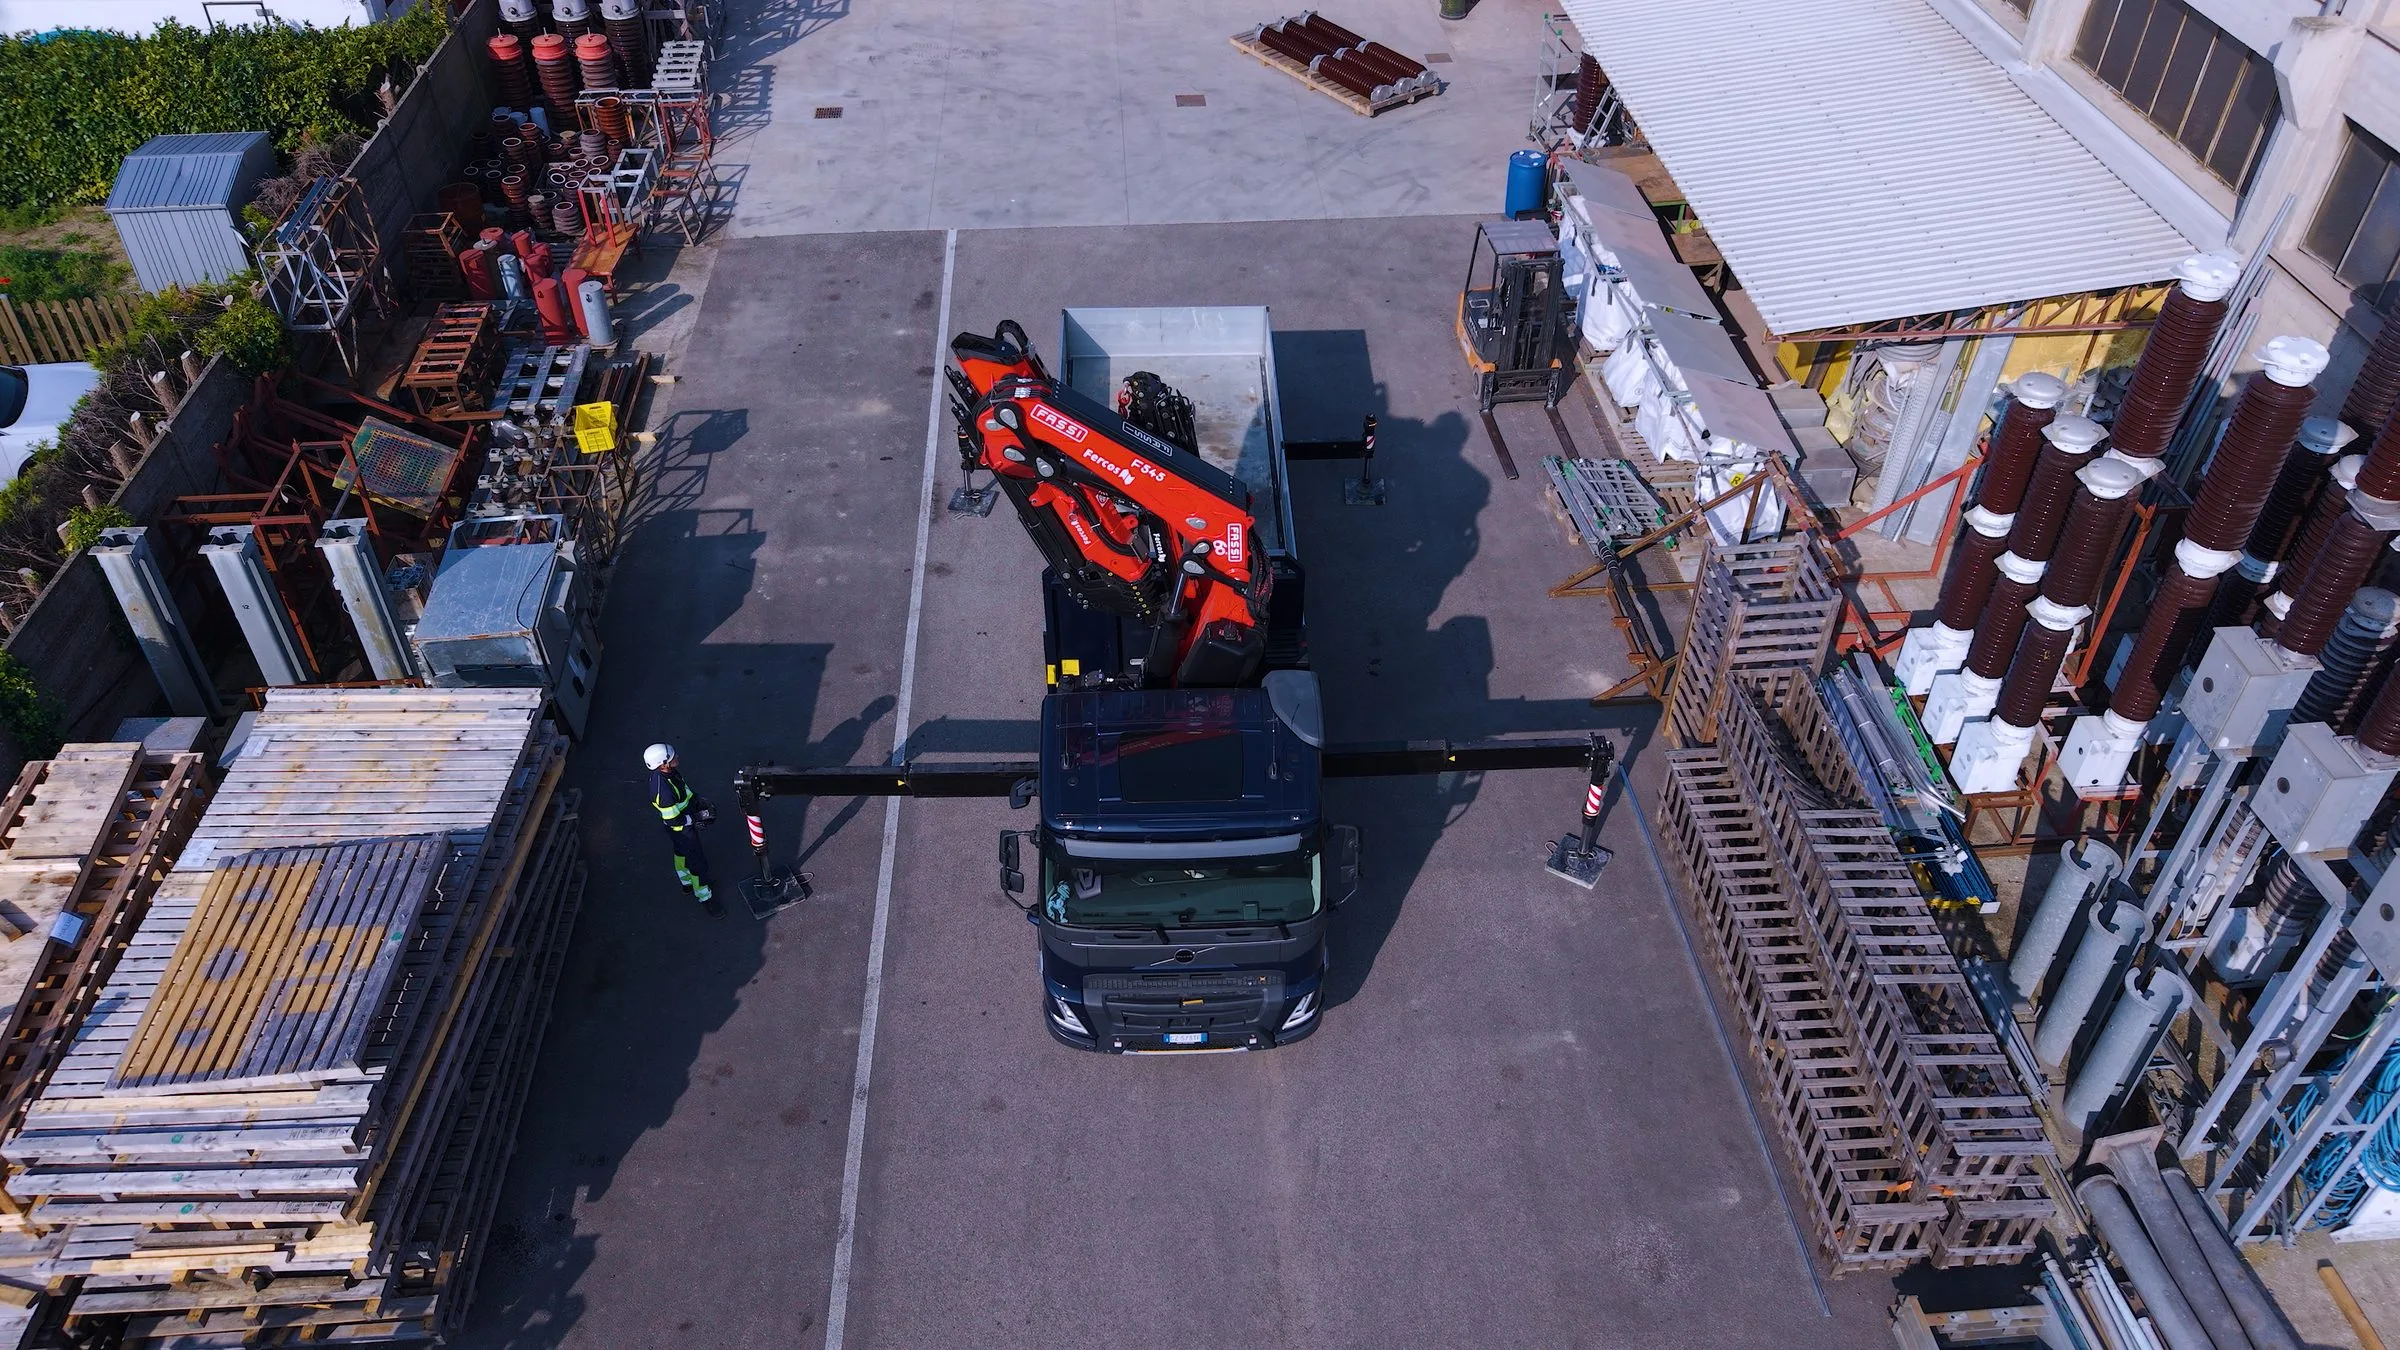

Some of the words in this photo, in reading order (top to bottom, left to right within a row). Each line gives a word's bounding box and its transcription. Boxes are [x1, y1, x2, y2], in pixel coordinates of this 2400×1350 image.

[1035, 409, 1083, 439] FASSI
[1082, 448, 1121, 475] Fercos
[1130, 458, 1166, 482] F545
[1153, 533, 1164, 554] Fercos
[1230, 526, 1240, 559] FASSI
